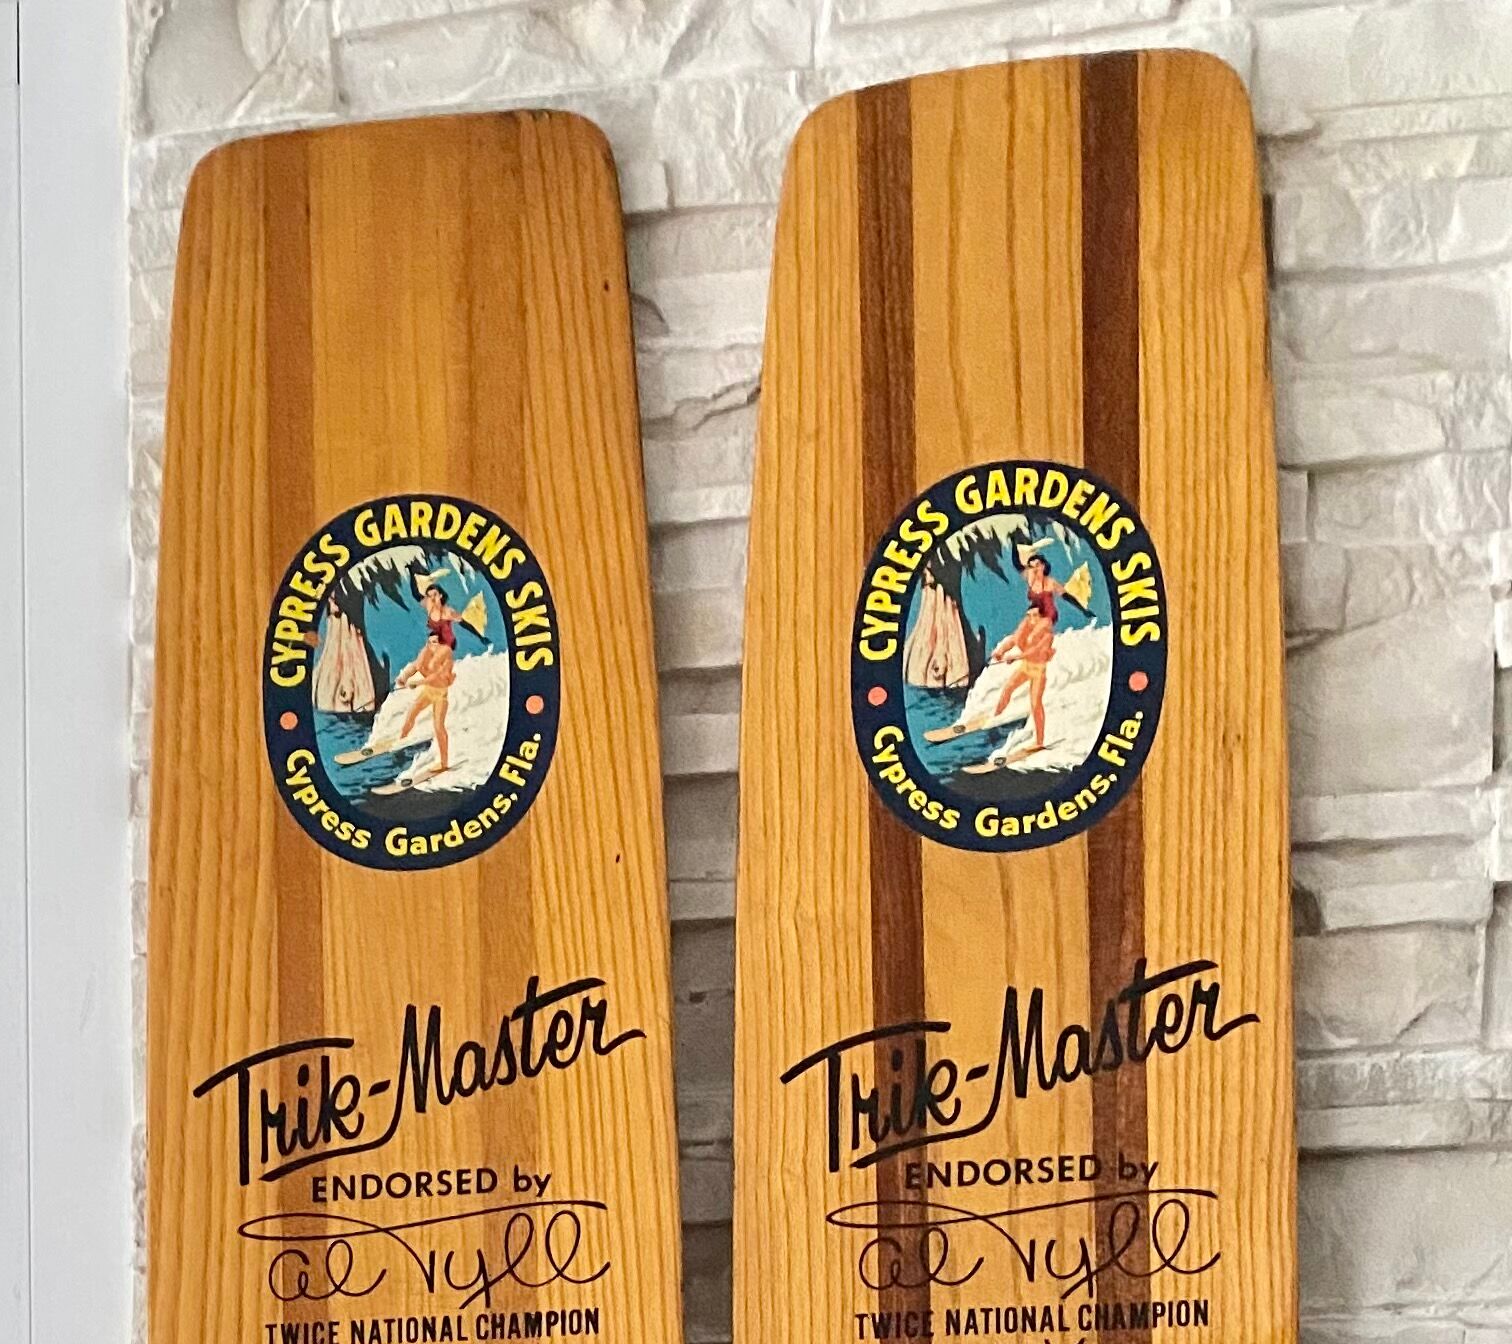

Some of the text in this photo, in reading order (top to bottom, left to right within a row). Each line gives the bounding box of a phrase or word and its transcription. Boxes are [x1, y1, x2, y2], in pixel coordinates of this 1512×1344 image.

[270, 501, 554, 687] CYPRESS GARDENS SKIS
[859, 467, 1162, 661] CYPRESS GARDENS SKIS
[285, 748, 372, 850] Cypress
[499, 732, 542, 788] Fla.
[871, 725, 961, 831] Cypress
[1097, 710, 1143, 767] Fla.
[193, 975, 647, 1186] Trik-Master
[780, 957, 1261, 1173] Trik-Master
[311, 1165, 552, 1203] ENDORSED by
[904, 1153, 1159, 1190] ENDORSED by
[475, 1306, 601, 1341] CHAMPION
[855, 1298, 1209, 1340] TWICE NATIONAL CHAMPION
